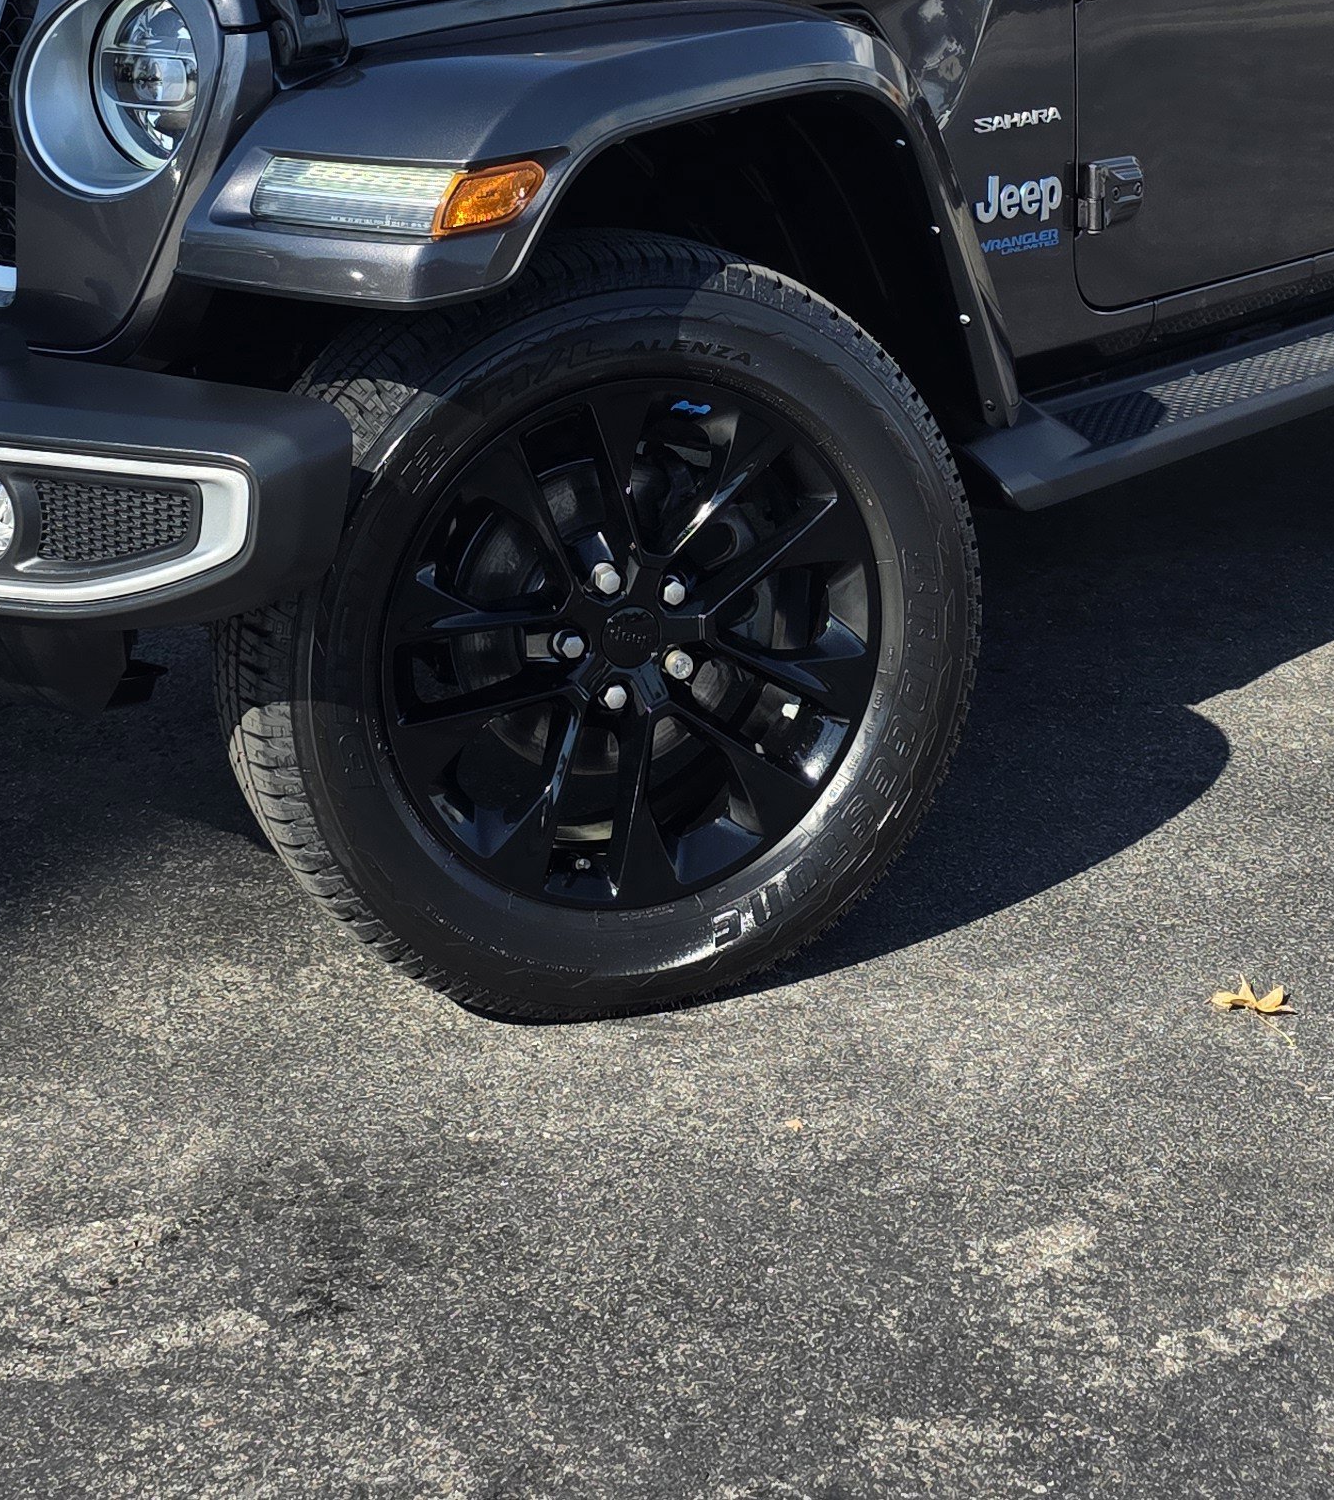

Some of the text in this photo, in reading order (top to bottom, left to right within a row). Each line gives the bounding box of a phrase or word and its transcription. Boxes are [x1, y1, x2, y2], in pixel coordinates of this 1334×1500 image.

[974, 106, 1062, 133] SAHARA
[975, 175, 1063, 224] Jeep
[981, 229, 1059, 253] WRANGLER
[1001, 239, 1059, 255] UNLIMITED
[631, 339, 753, 366] ALENZA
